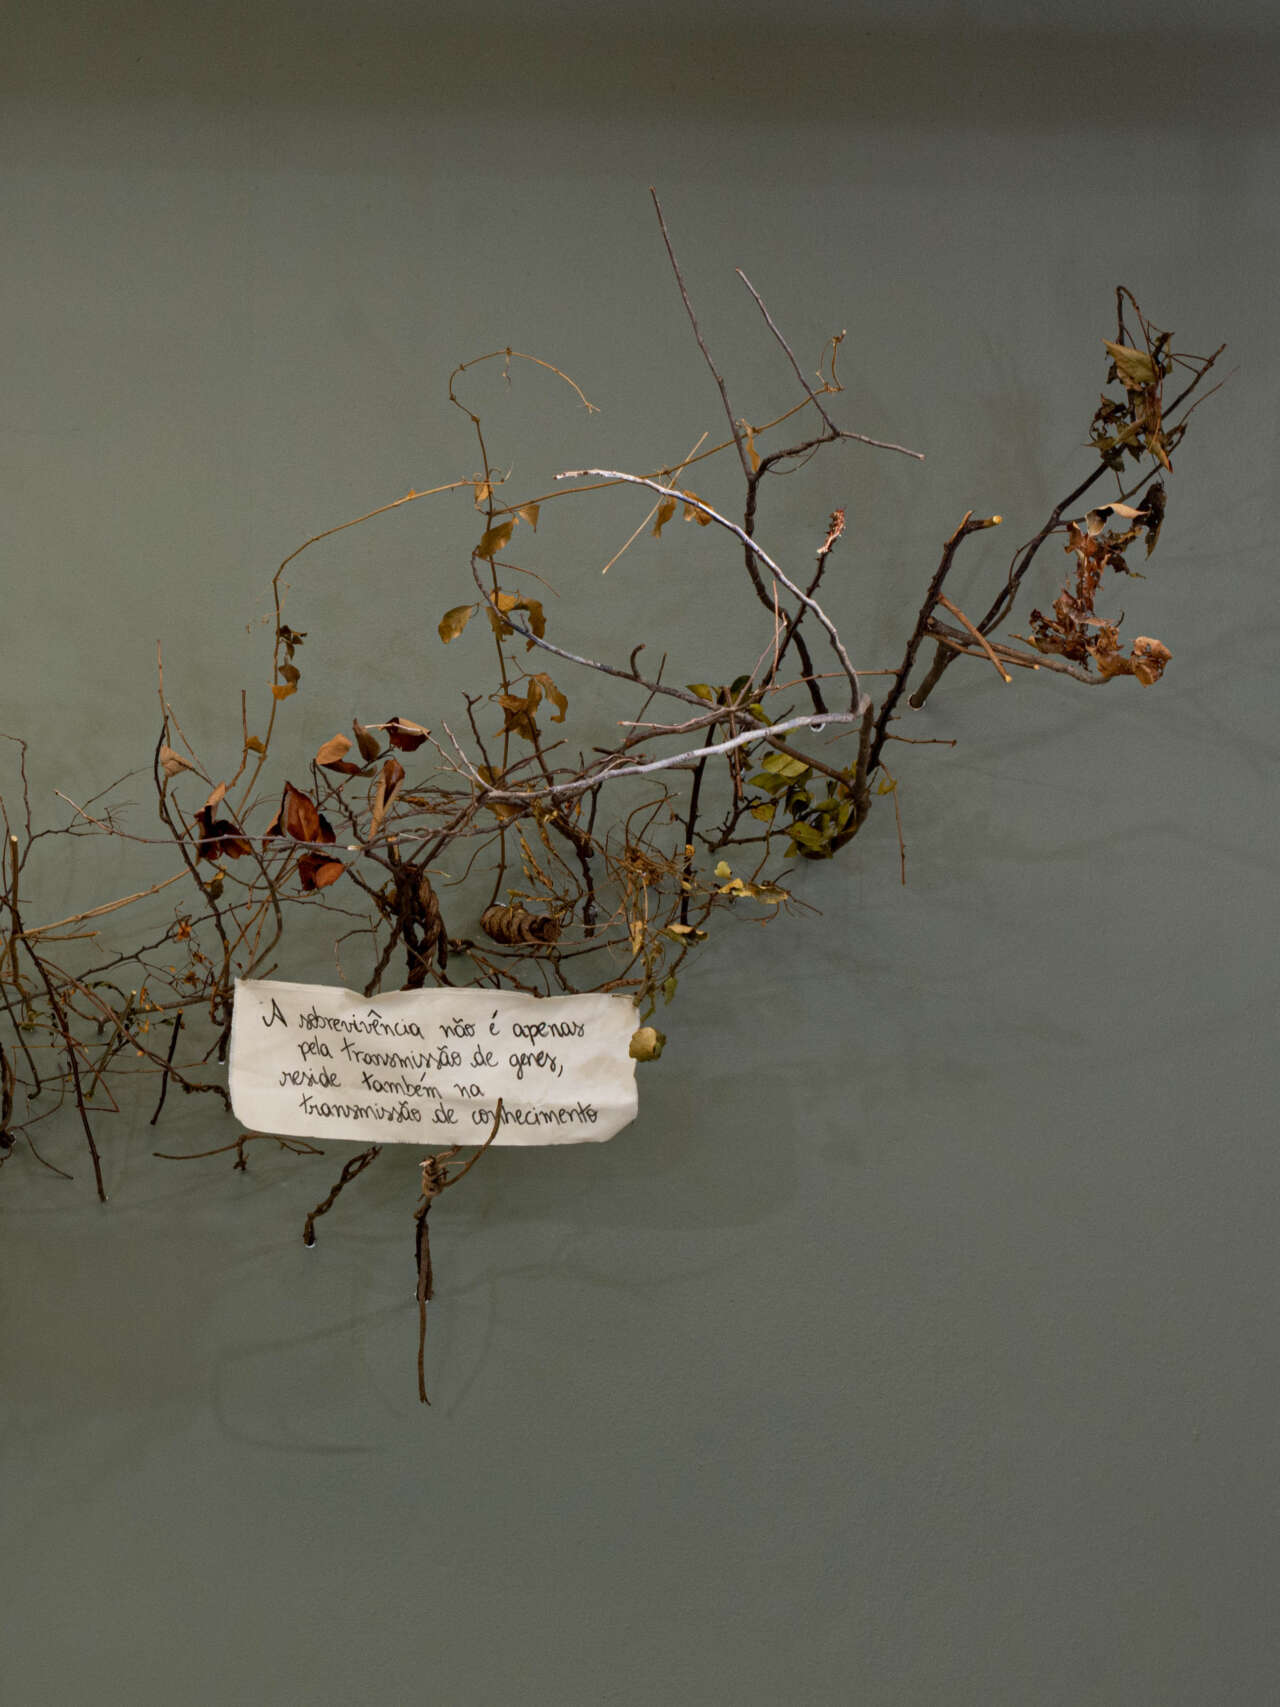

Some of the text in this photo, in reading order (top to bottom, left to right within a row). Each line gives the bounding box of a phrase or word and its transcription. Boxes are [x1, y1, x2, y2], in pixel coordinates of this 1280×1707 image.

[262, 997, 585, 1046] A sobrevivência não é apenas
[298, 1035, 564, 1080] pela transmissão de genes,
[279, 1066, 485, 1099] reside também na
[299, 1093, 598, 1126] transmissão de conhecimento
